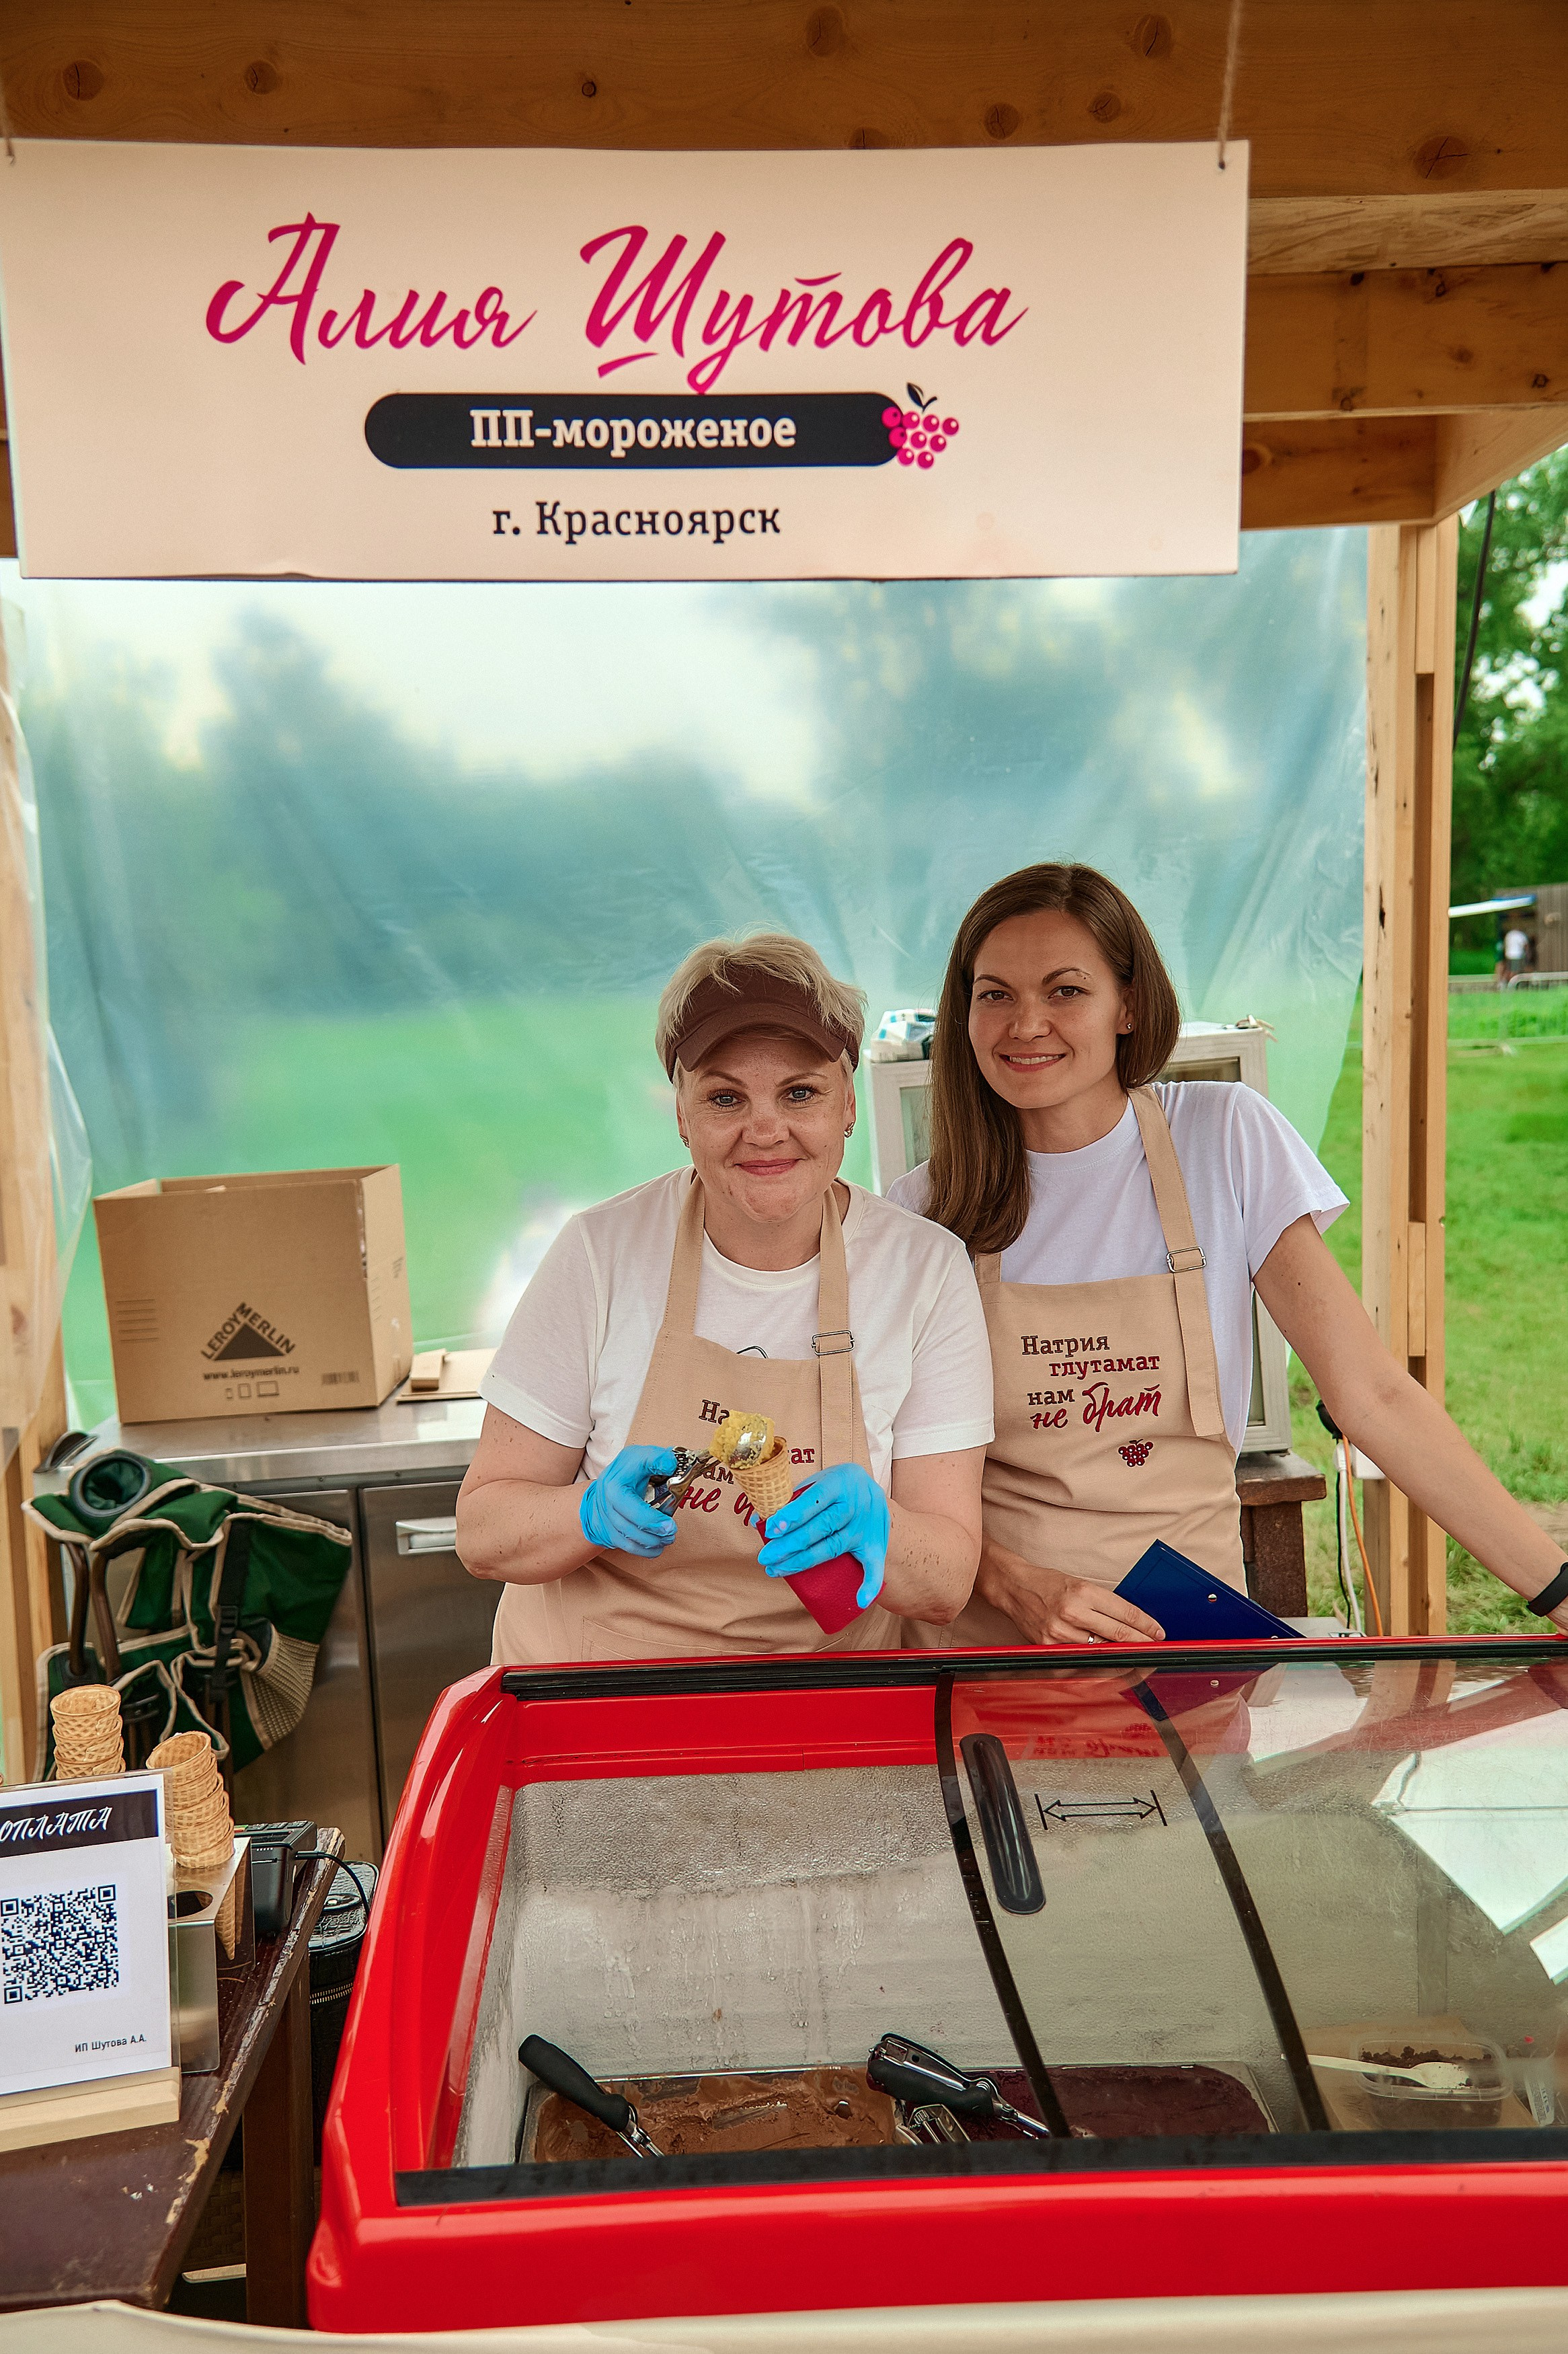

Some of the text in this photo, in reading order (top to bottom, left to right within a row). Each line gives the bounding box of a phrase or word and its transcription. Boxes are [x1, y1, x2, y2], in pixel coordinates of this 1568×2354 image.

[206, 213, 1029, 394] Алия Шутова
[469, 408, 797, 458] ПП-мороженое
[492, 501, 781, 545] г. Красноярск
[201, 1302, 296, 1360] LEROY MERLIN
[1020, 1334, 1110, 1358] Натрия
[1049, 1355, 1161, 1379] глутамат
[1027, 1388, 1075, 1406] нам
[1029, 1381, 1162, 1433] не брат
[0, 1806, 113, 1844] ОПЛАТА
[75, 2042, 88, 2053] ИП
[91, 2037, 127, 2051] Шутова
